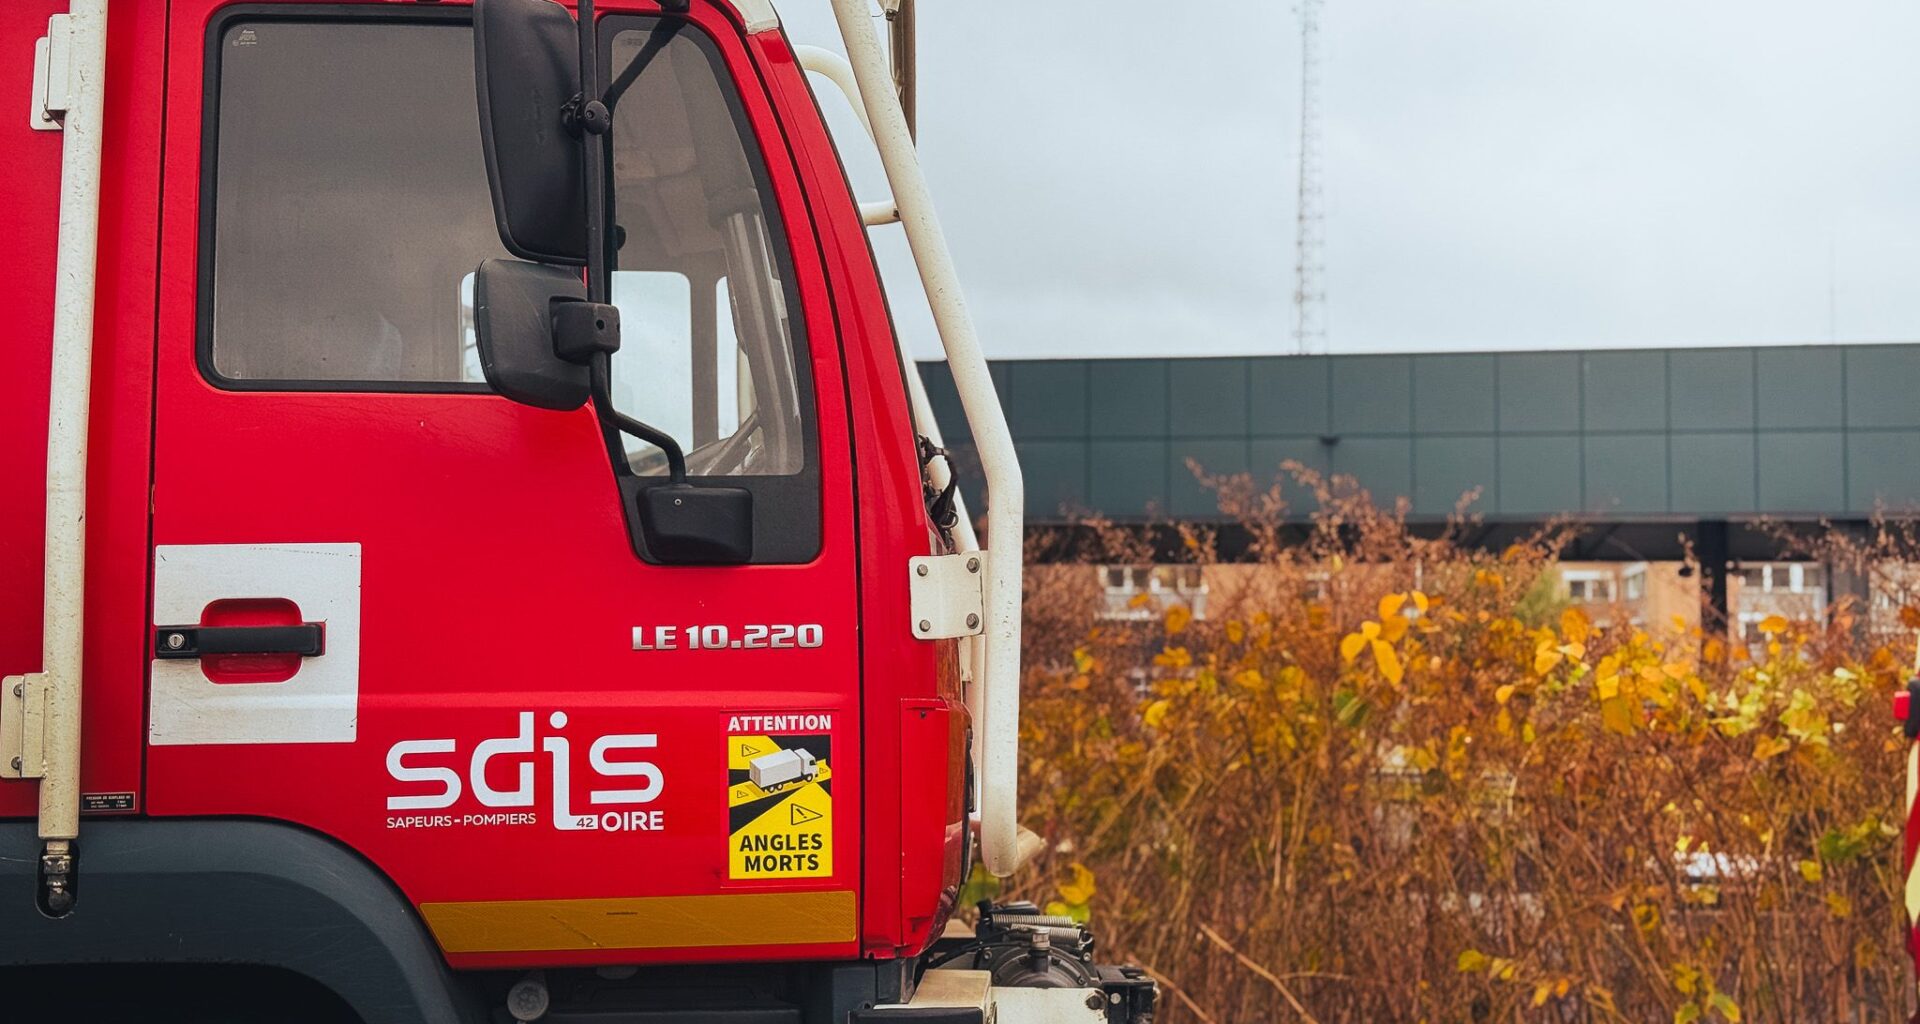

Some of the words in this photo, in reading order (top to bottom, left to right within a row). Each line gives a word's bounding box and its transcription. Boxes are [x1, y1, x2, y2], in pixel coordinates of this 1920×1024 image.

[632, 625, 677, 650] LE
[685, 624, 824, 649] 10.220
[727, 714, 832, 732] ATTENTION
[576, 817, 594, 829] 42
[739, 833, 823, 852] ANGLES
[744, 854, 820, 873] MORTS
